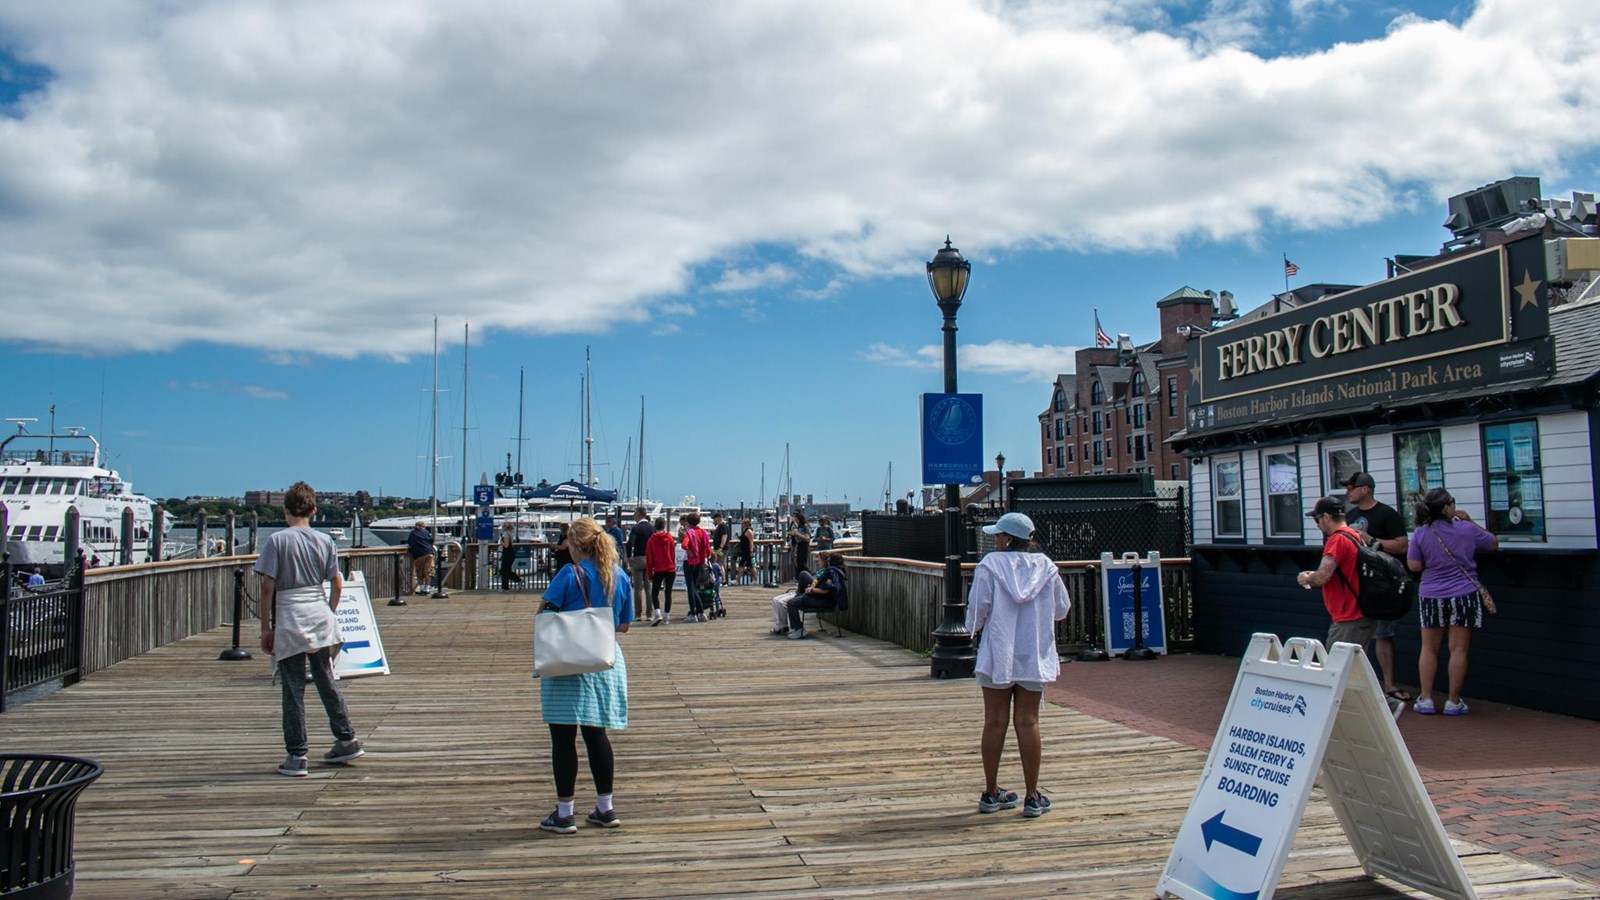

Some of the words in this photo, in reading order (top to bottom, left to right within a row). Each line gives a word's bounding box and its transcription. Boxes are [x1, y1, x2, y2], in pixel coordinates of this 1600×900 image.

[1217, 324, 1305, 381] FERRY
[1308, 282, 1465, 359] CENTER
[1217, 405, 1248, 420] Boston
[1250, 395, 1288, 414] Harbor
[1291, 386, 1334, 408] Islands
[1337, 373, 1397, 400] National
[1401, 367, 1438, 390] Park
[1443, 363, 1482, 384] Area
[480, 492, 488, 502] 5
[1251, 697, 1291, 714] citycruises
[1255, 686, 1275, 698] Boston
[1275, 690, 1295, 702] Harbor
[1229, 725, 1265, 744] HARBOR
[1265, 734, 1306, 757] ISLANDS,
[1229, 742, 1258, 761] SALEM
[1257, 749, 1287, 768] FERRY
[1286, 759, 1295, 771] &
[1223, 757, 1257, 776] SUNSET
[1256, 766, 1290, 786] CRUISE
[1217, 776, 1279, 808] BOARDING
